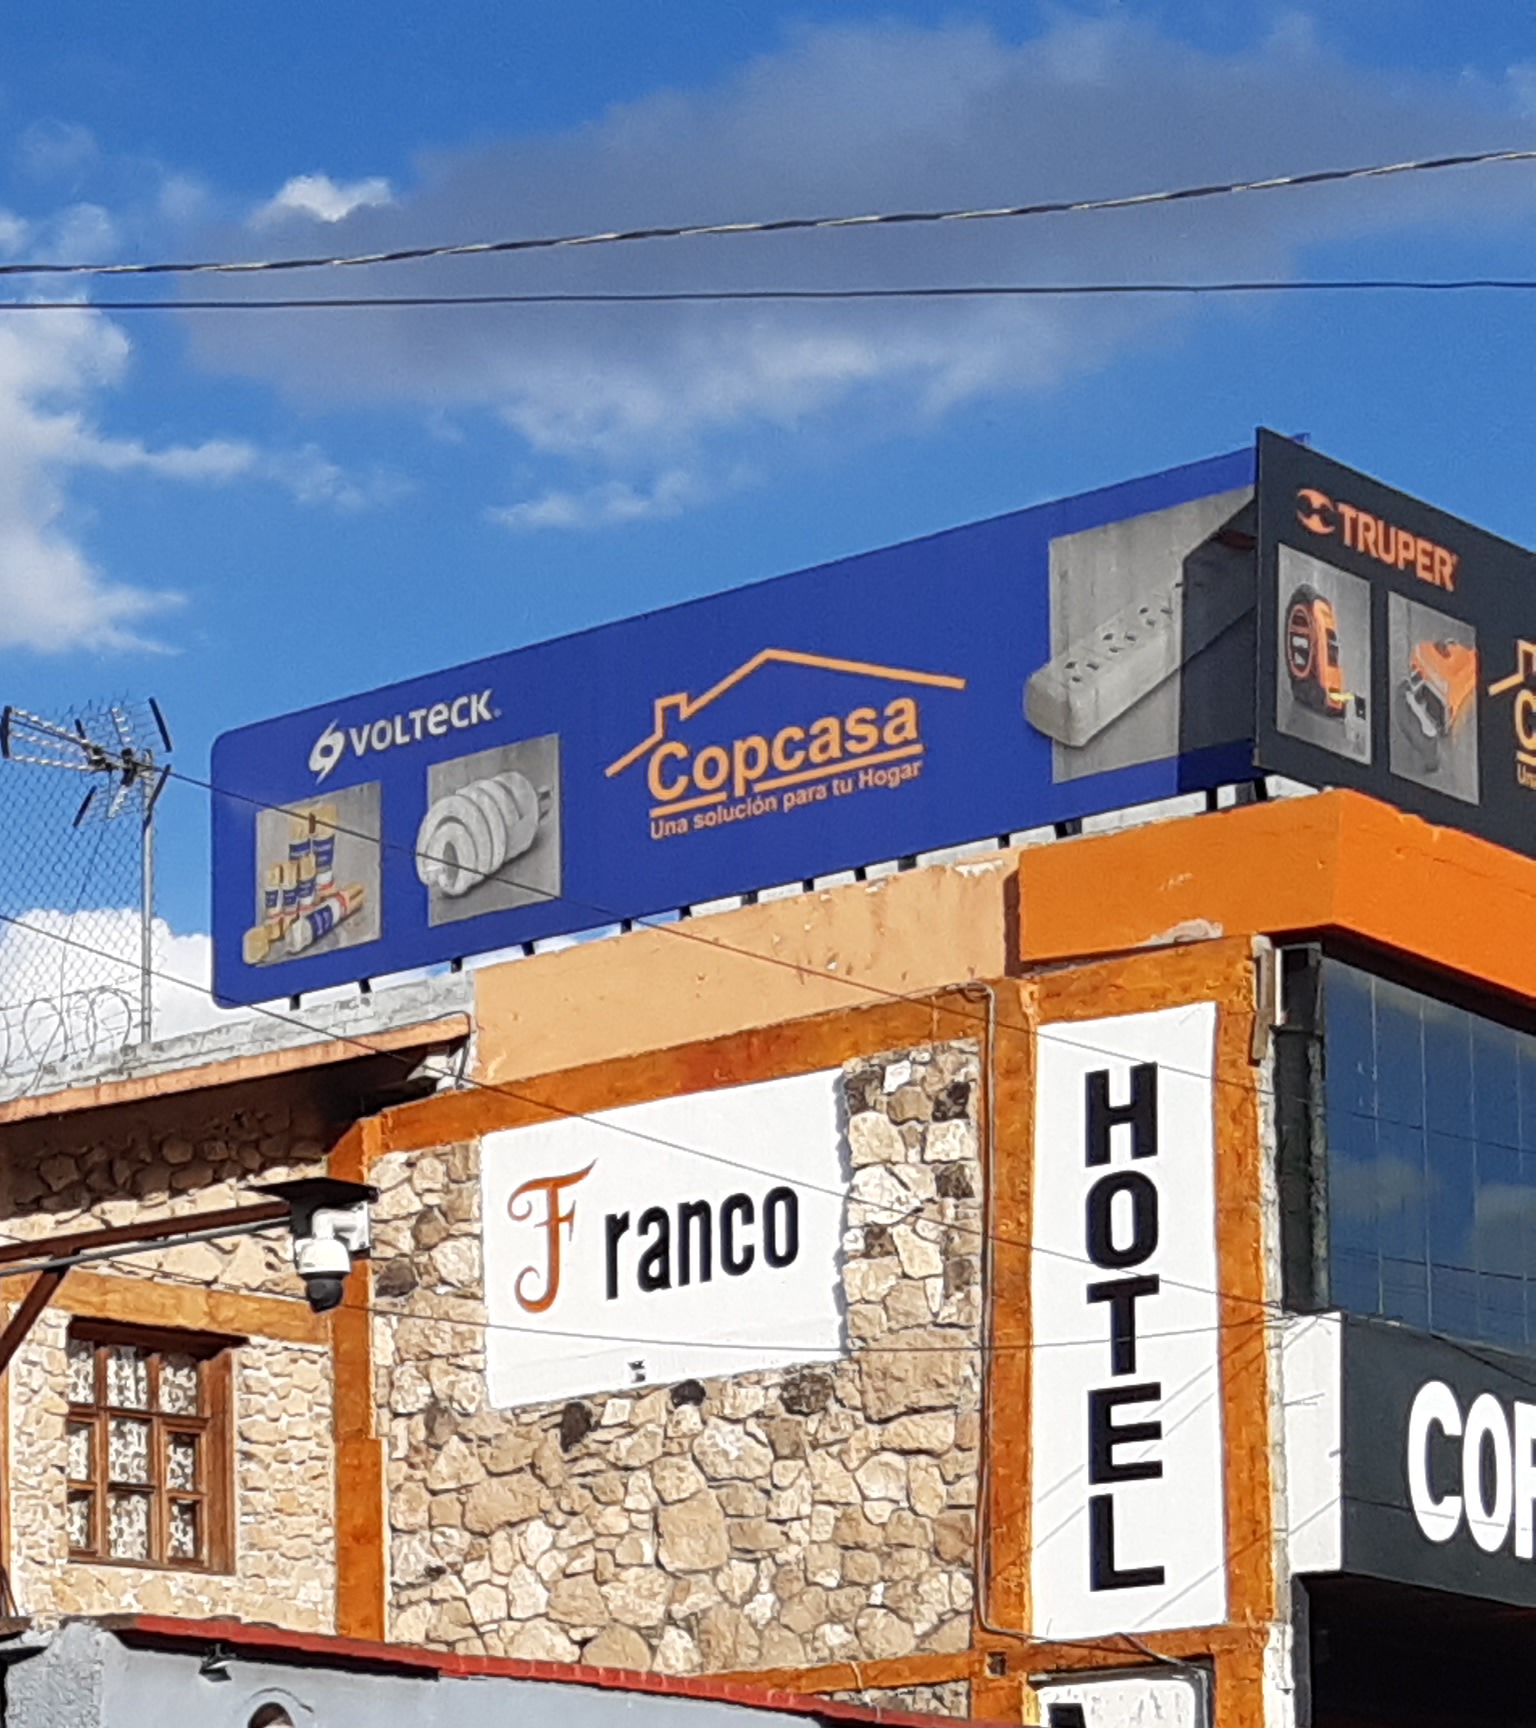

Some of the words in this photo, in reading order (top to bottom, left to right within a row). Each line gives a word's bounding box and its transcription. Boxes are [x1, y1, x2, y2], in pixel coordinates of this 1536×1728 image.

[1337, 502, 1455, 592] TRUPER
[647, 697, 918, 800] Copcasa
[650, 816, 688, 841] Una
[693, 791, 777, 830] solución
[783, 783, 827, 813] para
[832, 776, 853, 796] tu
[858, 760, 923, 789] Hogar
[1084, 1061, 1166, 1592] HOTEL
